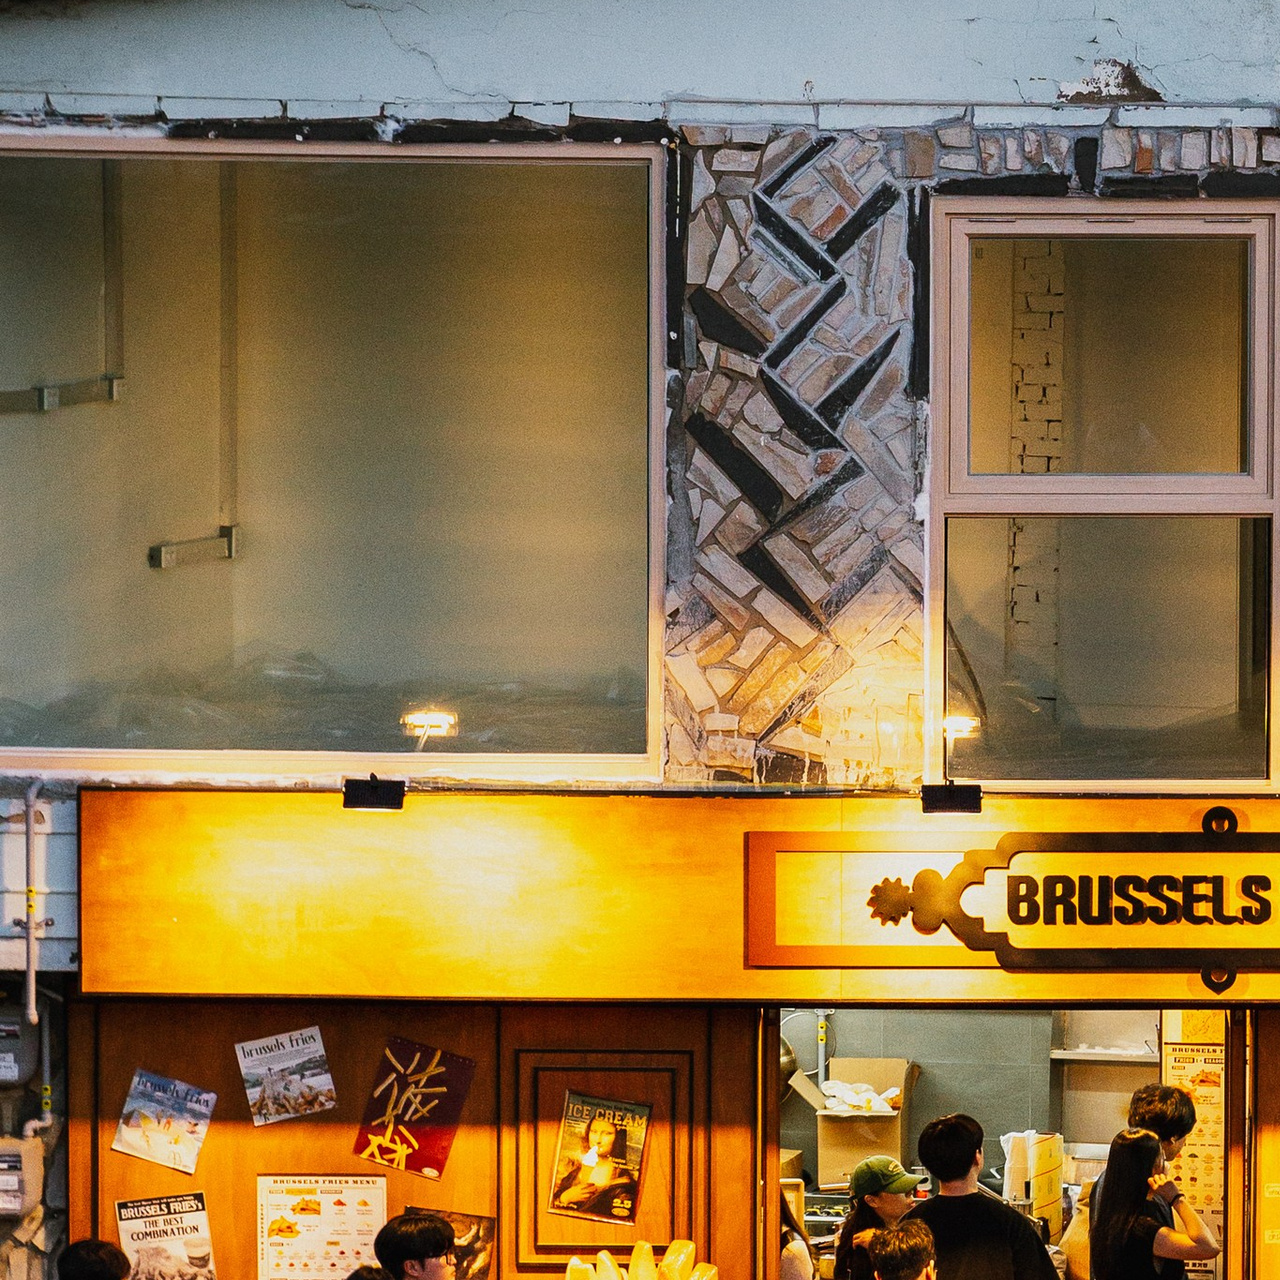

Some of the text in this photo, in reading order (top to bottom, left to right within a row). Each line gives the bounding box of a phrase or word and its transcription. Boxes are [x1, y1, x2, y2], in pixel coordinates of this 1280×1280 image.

[1006, 874, 1271, 926] BRUSSELS
[240, 1038, 286, 1060] brussels
[289, 1031, 317, 1049] fries
[136, 1071, 180, 1099] brussels
[183, 1088, 211, 1109] fries
[568, 1103, 592, 1119] ICE
[595, 1108, 648, 1128] CREAM
[120, 1203, 168, 1219] BRUSSELS
[143, 1216, 184, 1229] THE BEST
[130, 1225, 200, 1241] COMBINATION
